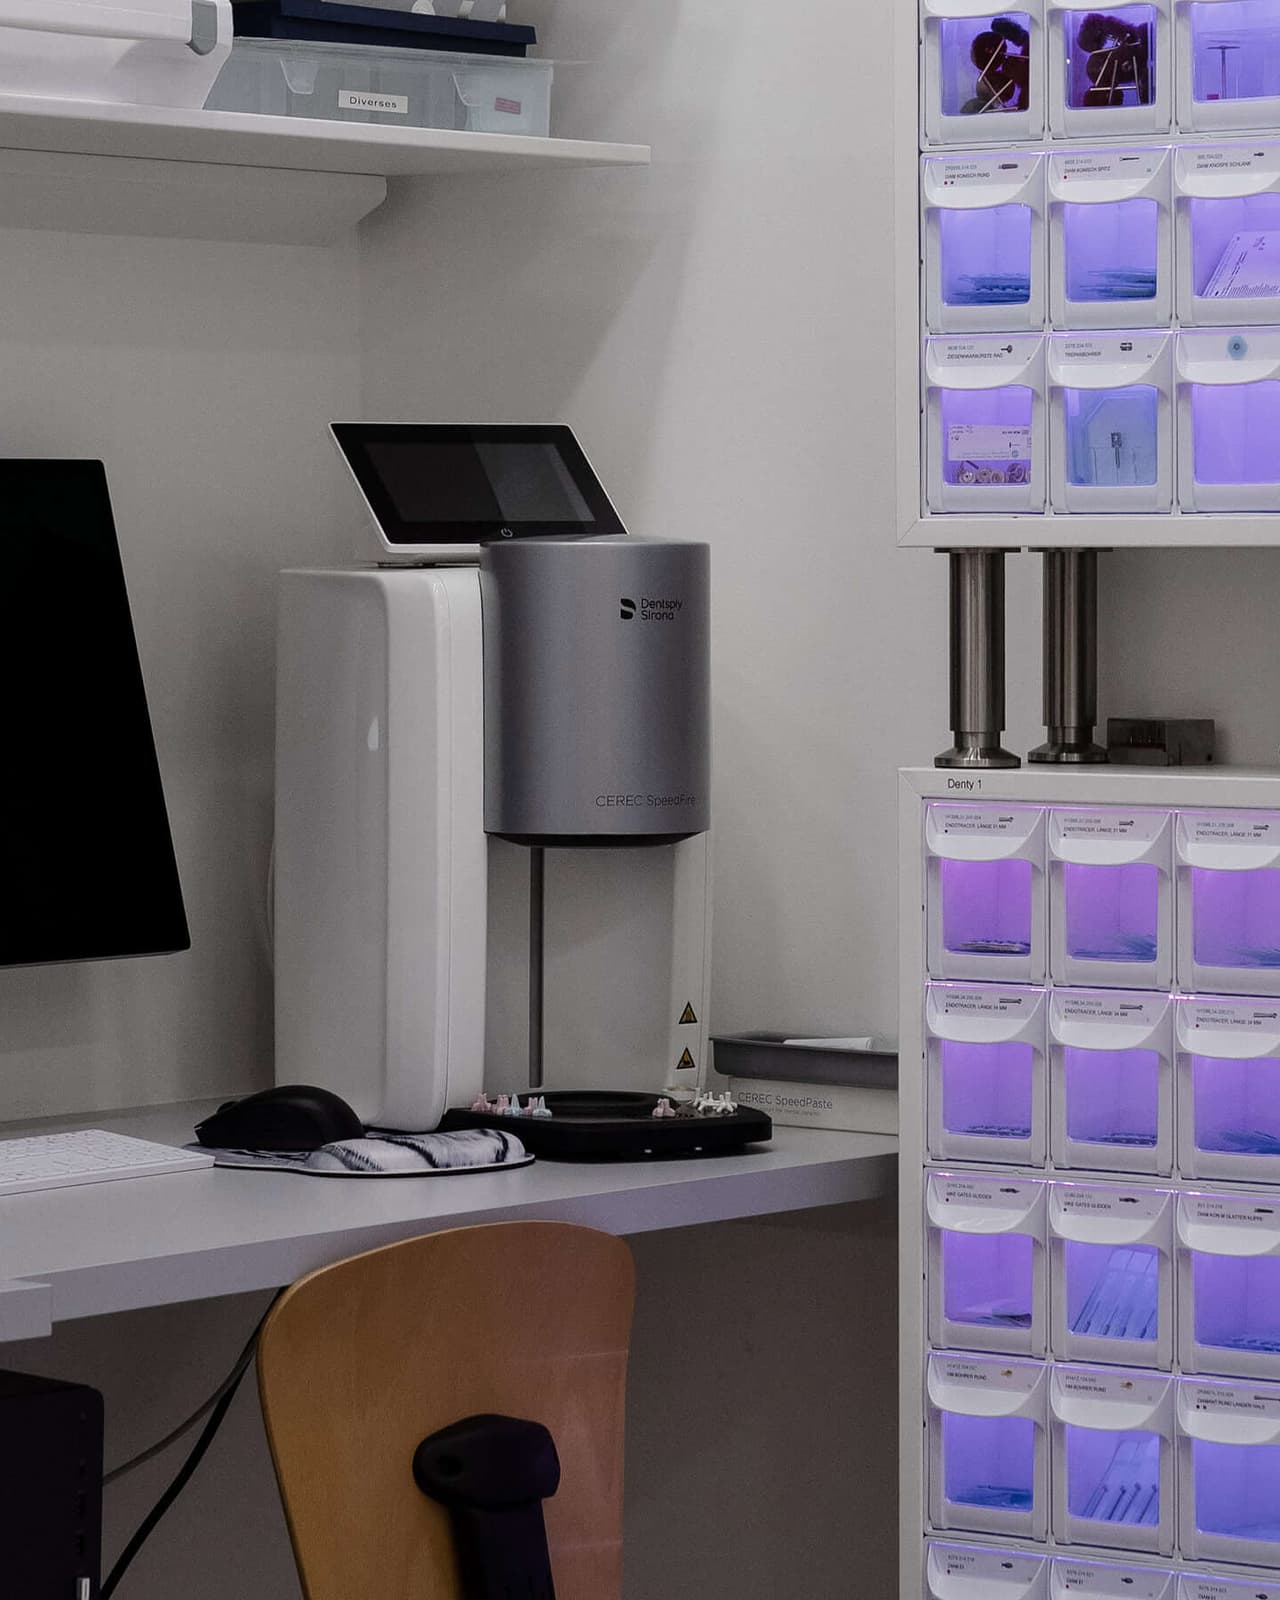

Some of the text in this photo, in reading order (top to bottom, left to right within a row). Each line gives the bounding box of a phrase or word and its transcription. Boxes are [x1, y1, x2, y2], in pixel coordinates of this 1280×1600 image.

[349, 96, 397, 109] Diverses
[641, 599, 682, 610] Dentsply
[641, 611, 674, 621] Sirona
[948, 779, 982, 791] Denty 1
[595, 795, 643, 807] CEREC
[737, 1092, 833, 1109] CEREC SpeedPaste
